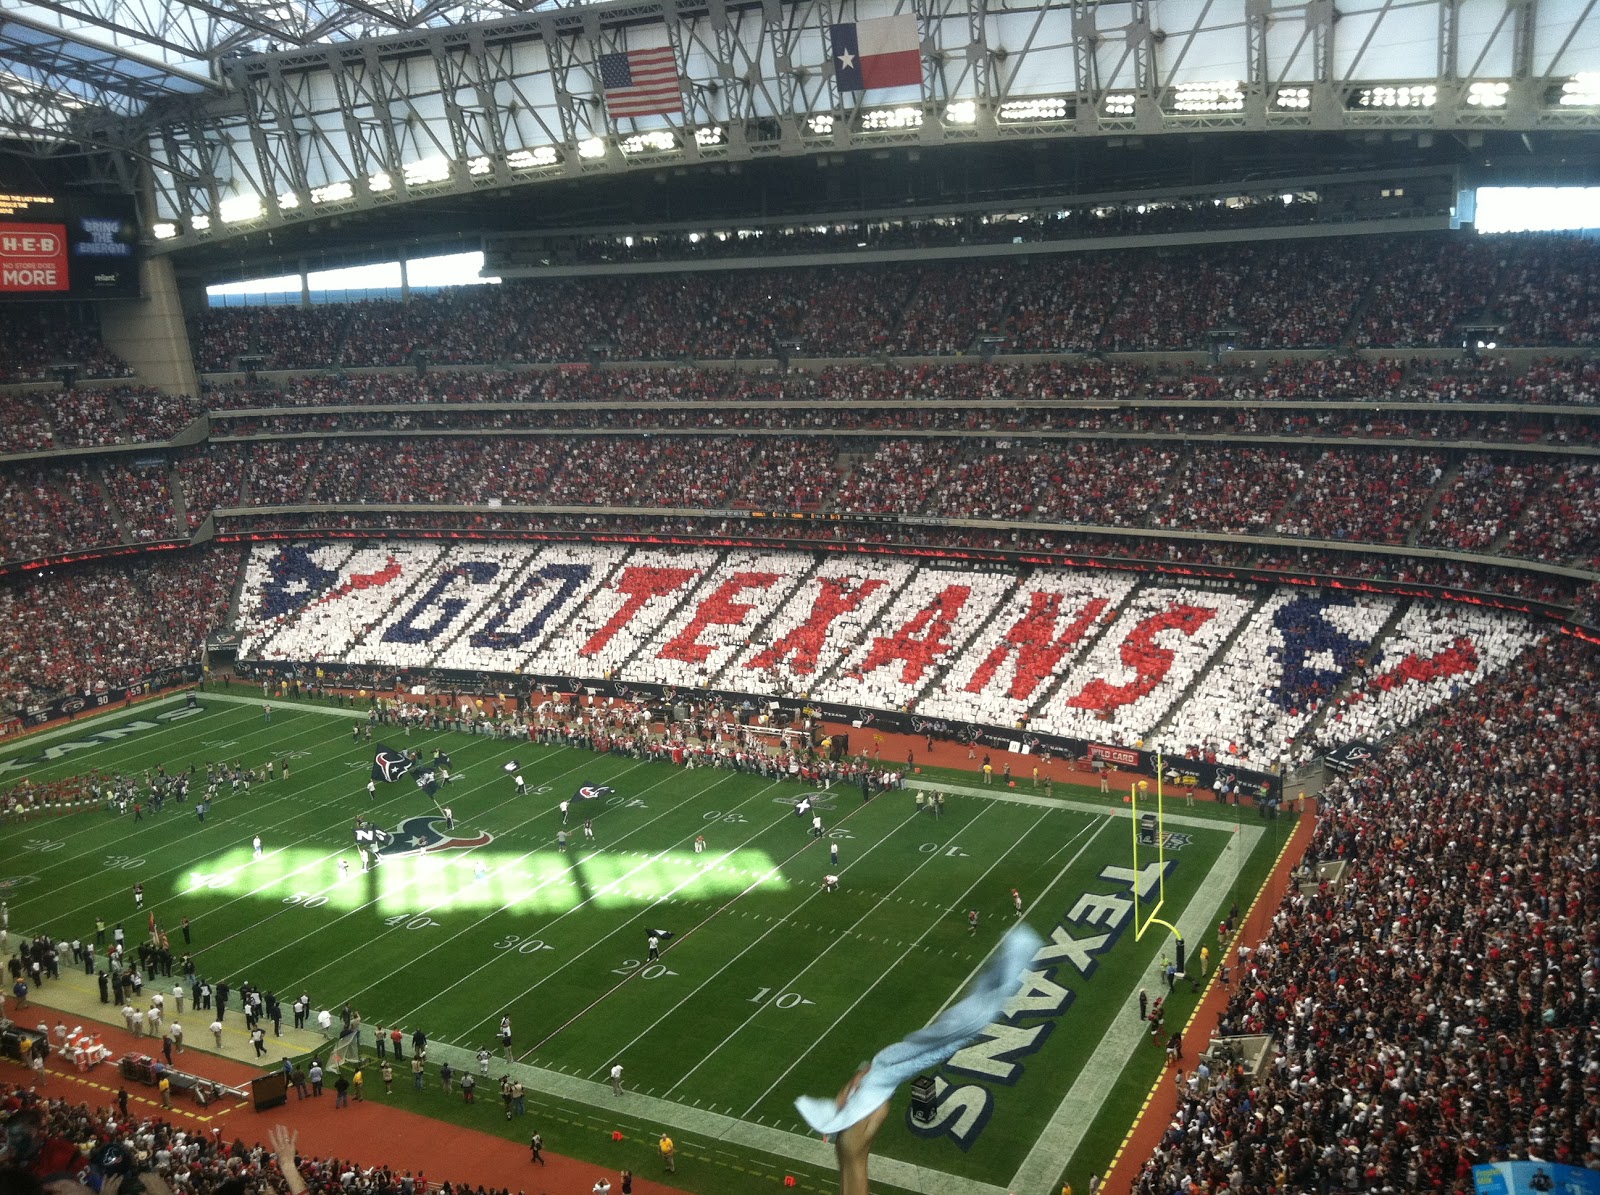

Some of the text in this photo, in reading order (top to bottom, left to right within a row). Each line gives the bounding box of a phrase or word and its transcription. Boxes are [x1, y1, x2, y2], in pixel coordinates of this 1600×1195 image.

[3, 270, 57, 285] MORE
[382, 561, 1216, 714] GO TEXANS
[1113, 751, 1134, 763] CARD
[384, 913, 431, 930] 40
[493, 934, 546, 955] 30
[611, 958, 668, 980] 20
[745, 986, 802, 1010] 10
